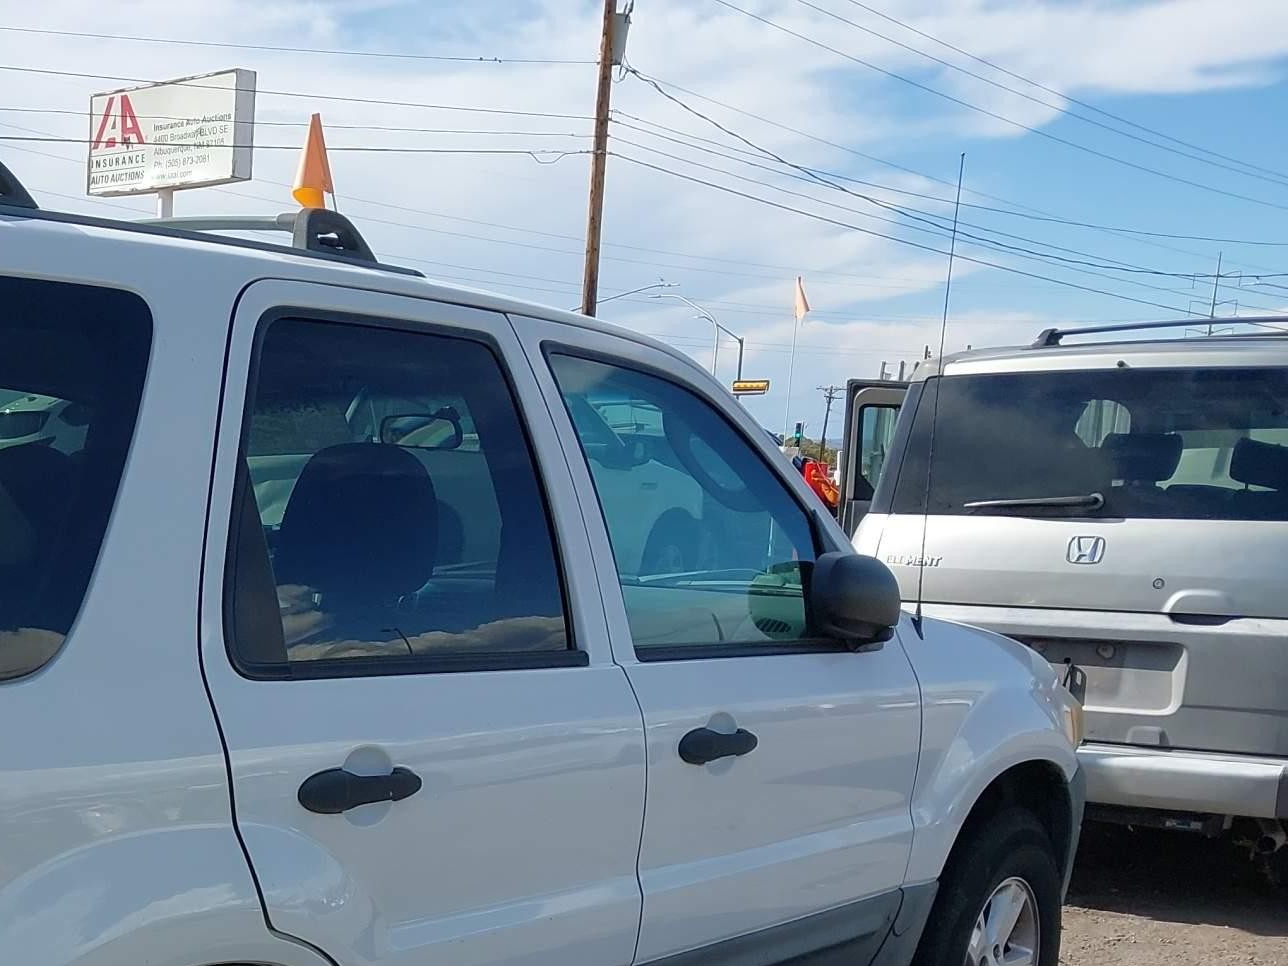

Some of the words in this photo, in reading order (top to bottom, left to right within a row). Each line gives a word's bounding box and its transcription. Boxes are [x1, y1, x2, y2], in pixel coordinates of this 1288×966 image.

[219, 124, 229, 134] SE
[91, 153, 145, 169] INSURANCE
[91, 173, 109, 186] AUTO
[110, 169, 145, 184] AUCTIONS
